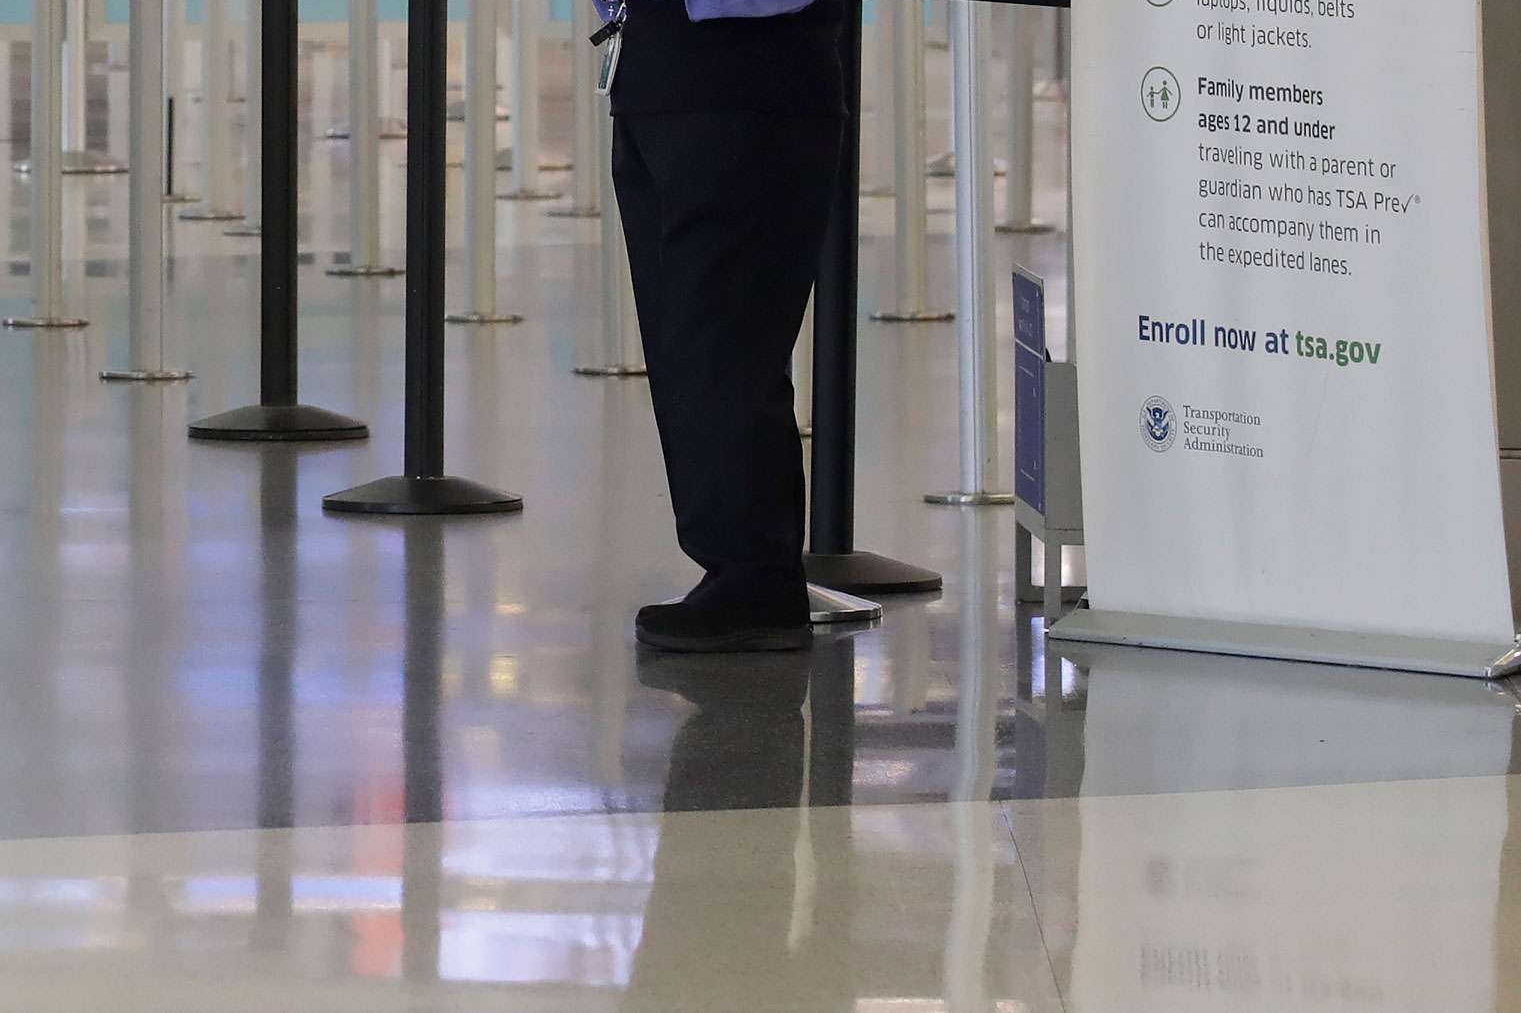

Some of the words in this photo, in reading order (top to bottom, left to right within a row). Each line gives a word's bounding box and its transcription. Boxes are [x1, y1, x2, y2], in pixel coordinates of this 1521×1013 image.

[1196, 25, 1213, 41] or
[1218, 22, 1246, 45] light
[1251, 26, 1312, 48] jackets.
[1198, 77, 1244, 102] Family
[1249, 83, 1323, 105] members
[1198, 113, 1230, 133] ages
[1233, 114, 1251, 133] 12
[1256, 116, 1289, 135] and
[1294, 121, 1335, 140] under
[1198, 143, 1263, 170] traveling
[1269, 149, 1305, 171] with
[1310, 158, 1317, 172] a
[1322, 157, 1375, 177] parent
[1380, 164, 1396, 178] or
[1199, 178, 1262, 200] guardian
[1269, 182, 1304, 203] who
[1308, 186, 1332, 207] has
[1337, 189, 1367, 210] TSA
[1374, 193, 1400, 213] Pre
[1199, 213, 1225, 230] can
[1228, 217, 1315, 241] accompany
[1319, 221, 1358, 243] them
[1366, 224, 1381, 245] in
[1199, 242, 1224, 262] the
[1228, 246, 1305, 270] expedited
[1309, 252, 1352, 276] lanes.
[1138, 315, 1205, 346] Enroll
[1214, 324, 1256, 352] now
[1265, 329, 1289, 355] at
[1295, 330, 1381, 367] tsa.gov
[1183, 405, 1261, 426] Transportation
[1183, 421, 1231, 440] Security
[1183, 437, 1264, 458] Administration
